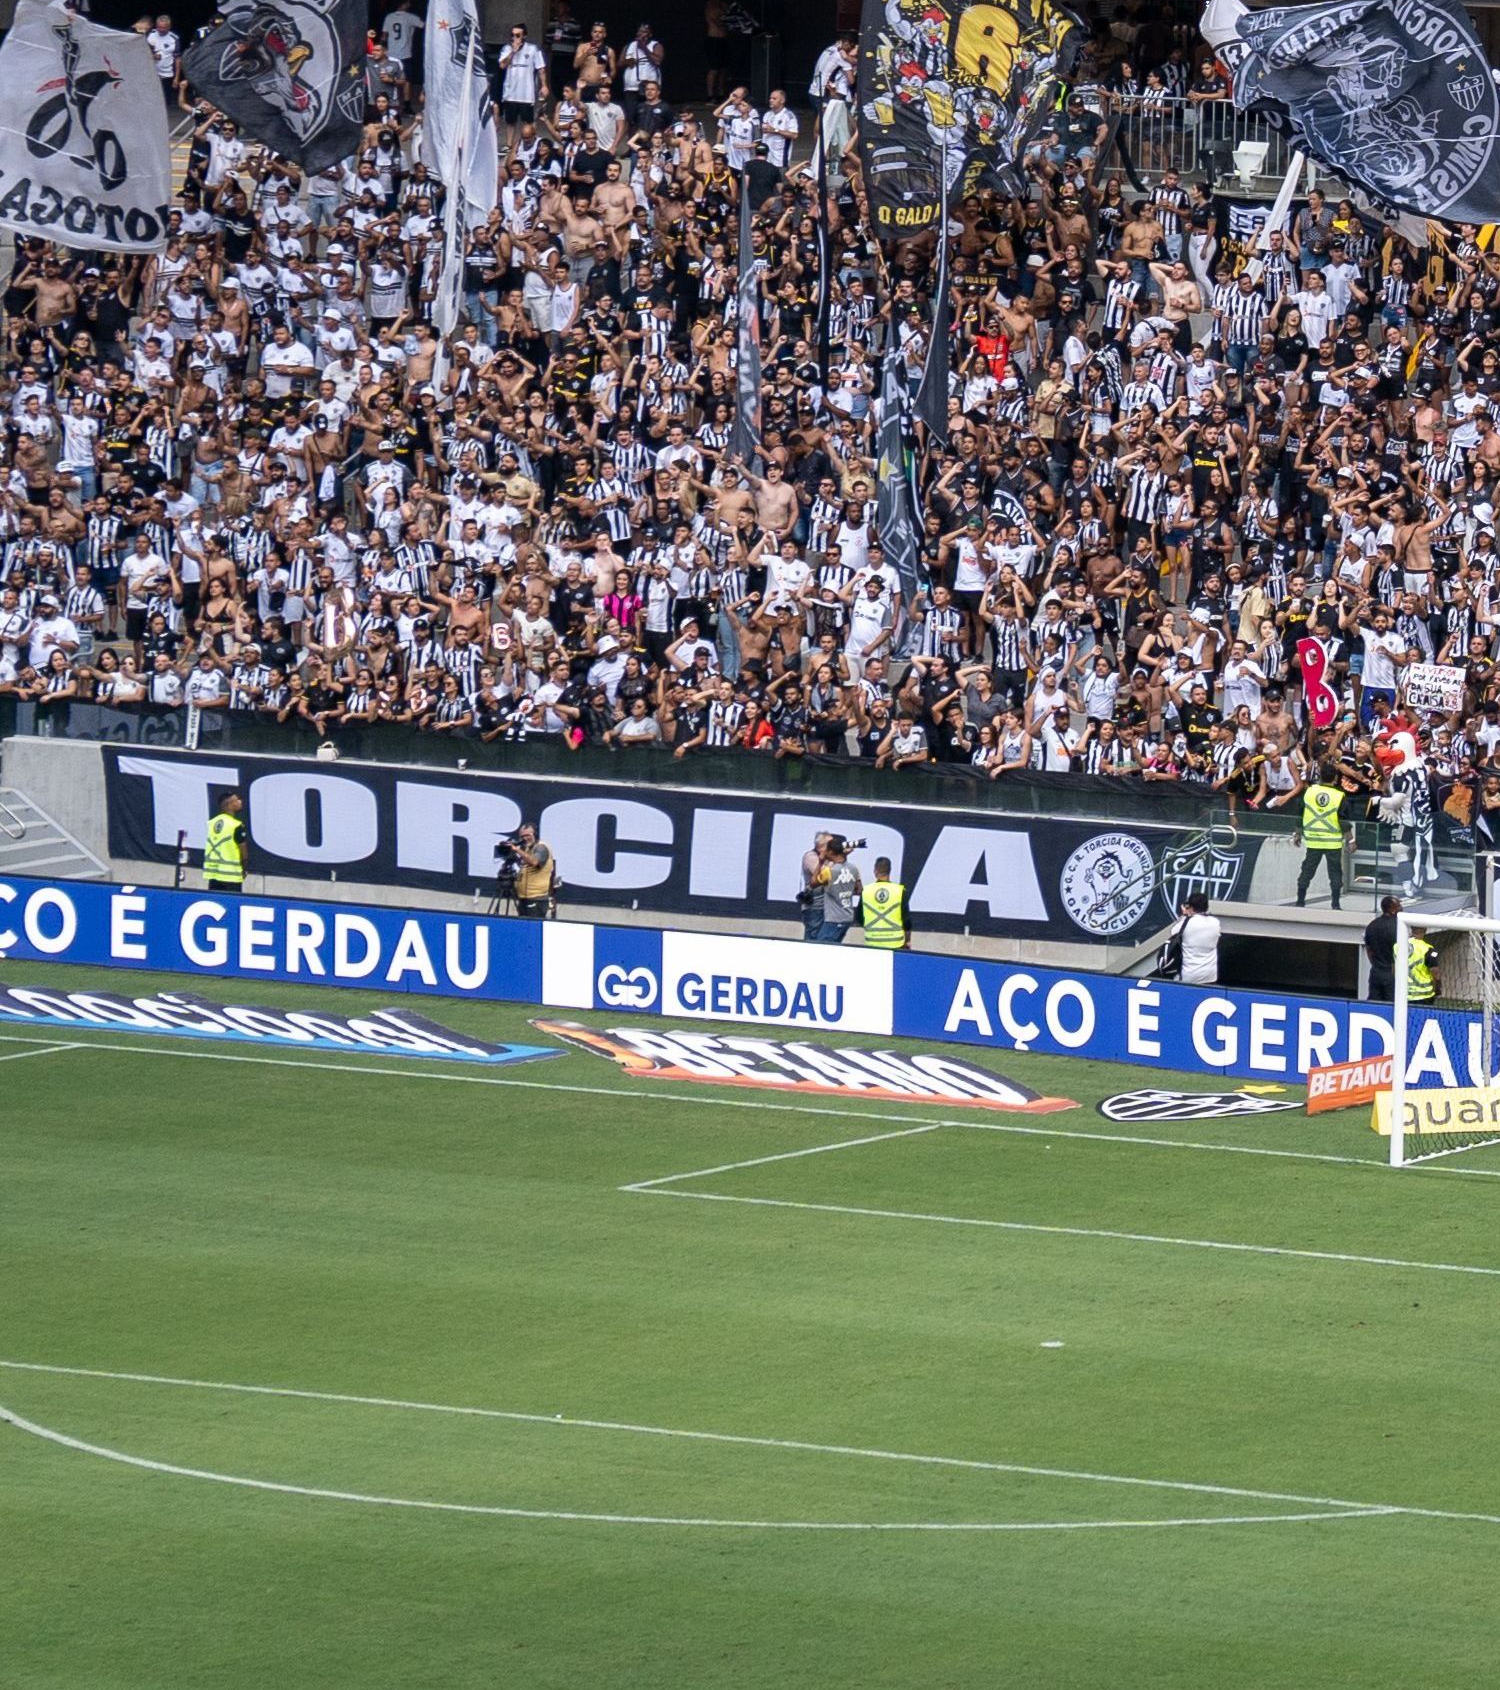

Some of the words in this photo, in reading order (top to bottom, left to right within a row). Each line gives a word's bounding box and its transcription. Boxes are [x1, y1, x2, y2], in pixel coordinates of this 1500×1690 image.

[878, 205, 889, 223] O
[895, 202, 931, 225] GALO
[1297, 635, 1338, 729] B
[1410, 683, 1422, 693] DA
[1424, 683, 1443, 694] SUA
[117, 756, 1048, 919] TORCIDA
[1086, 835, 1123, 855] TORCIDA
[1173, 855, 1229, 879] CAM
[111, 886, 147, 960] É
[180, 900, 489, 990] GERDAU
[678, 971, 844, 1023] GERDAU
[943, 967, 1096, 1051] AÇO
[1126, 978, 1161, 1057] É
[607, 1026, 1045, 1108] BETANO
[1308, 1058, 1394, 1095] BETANO
